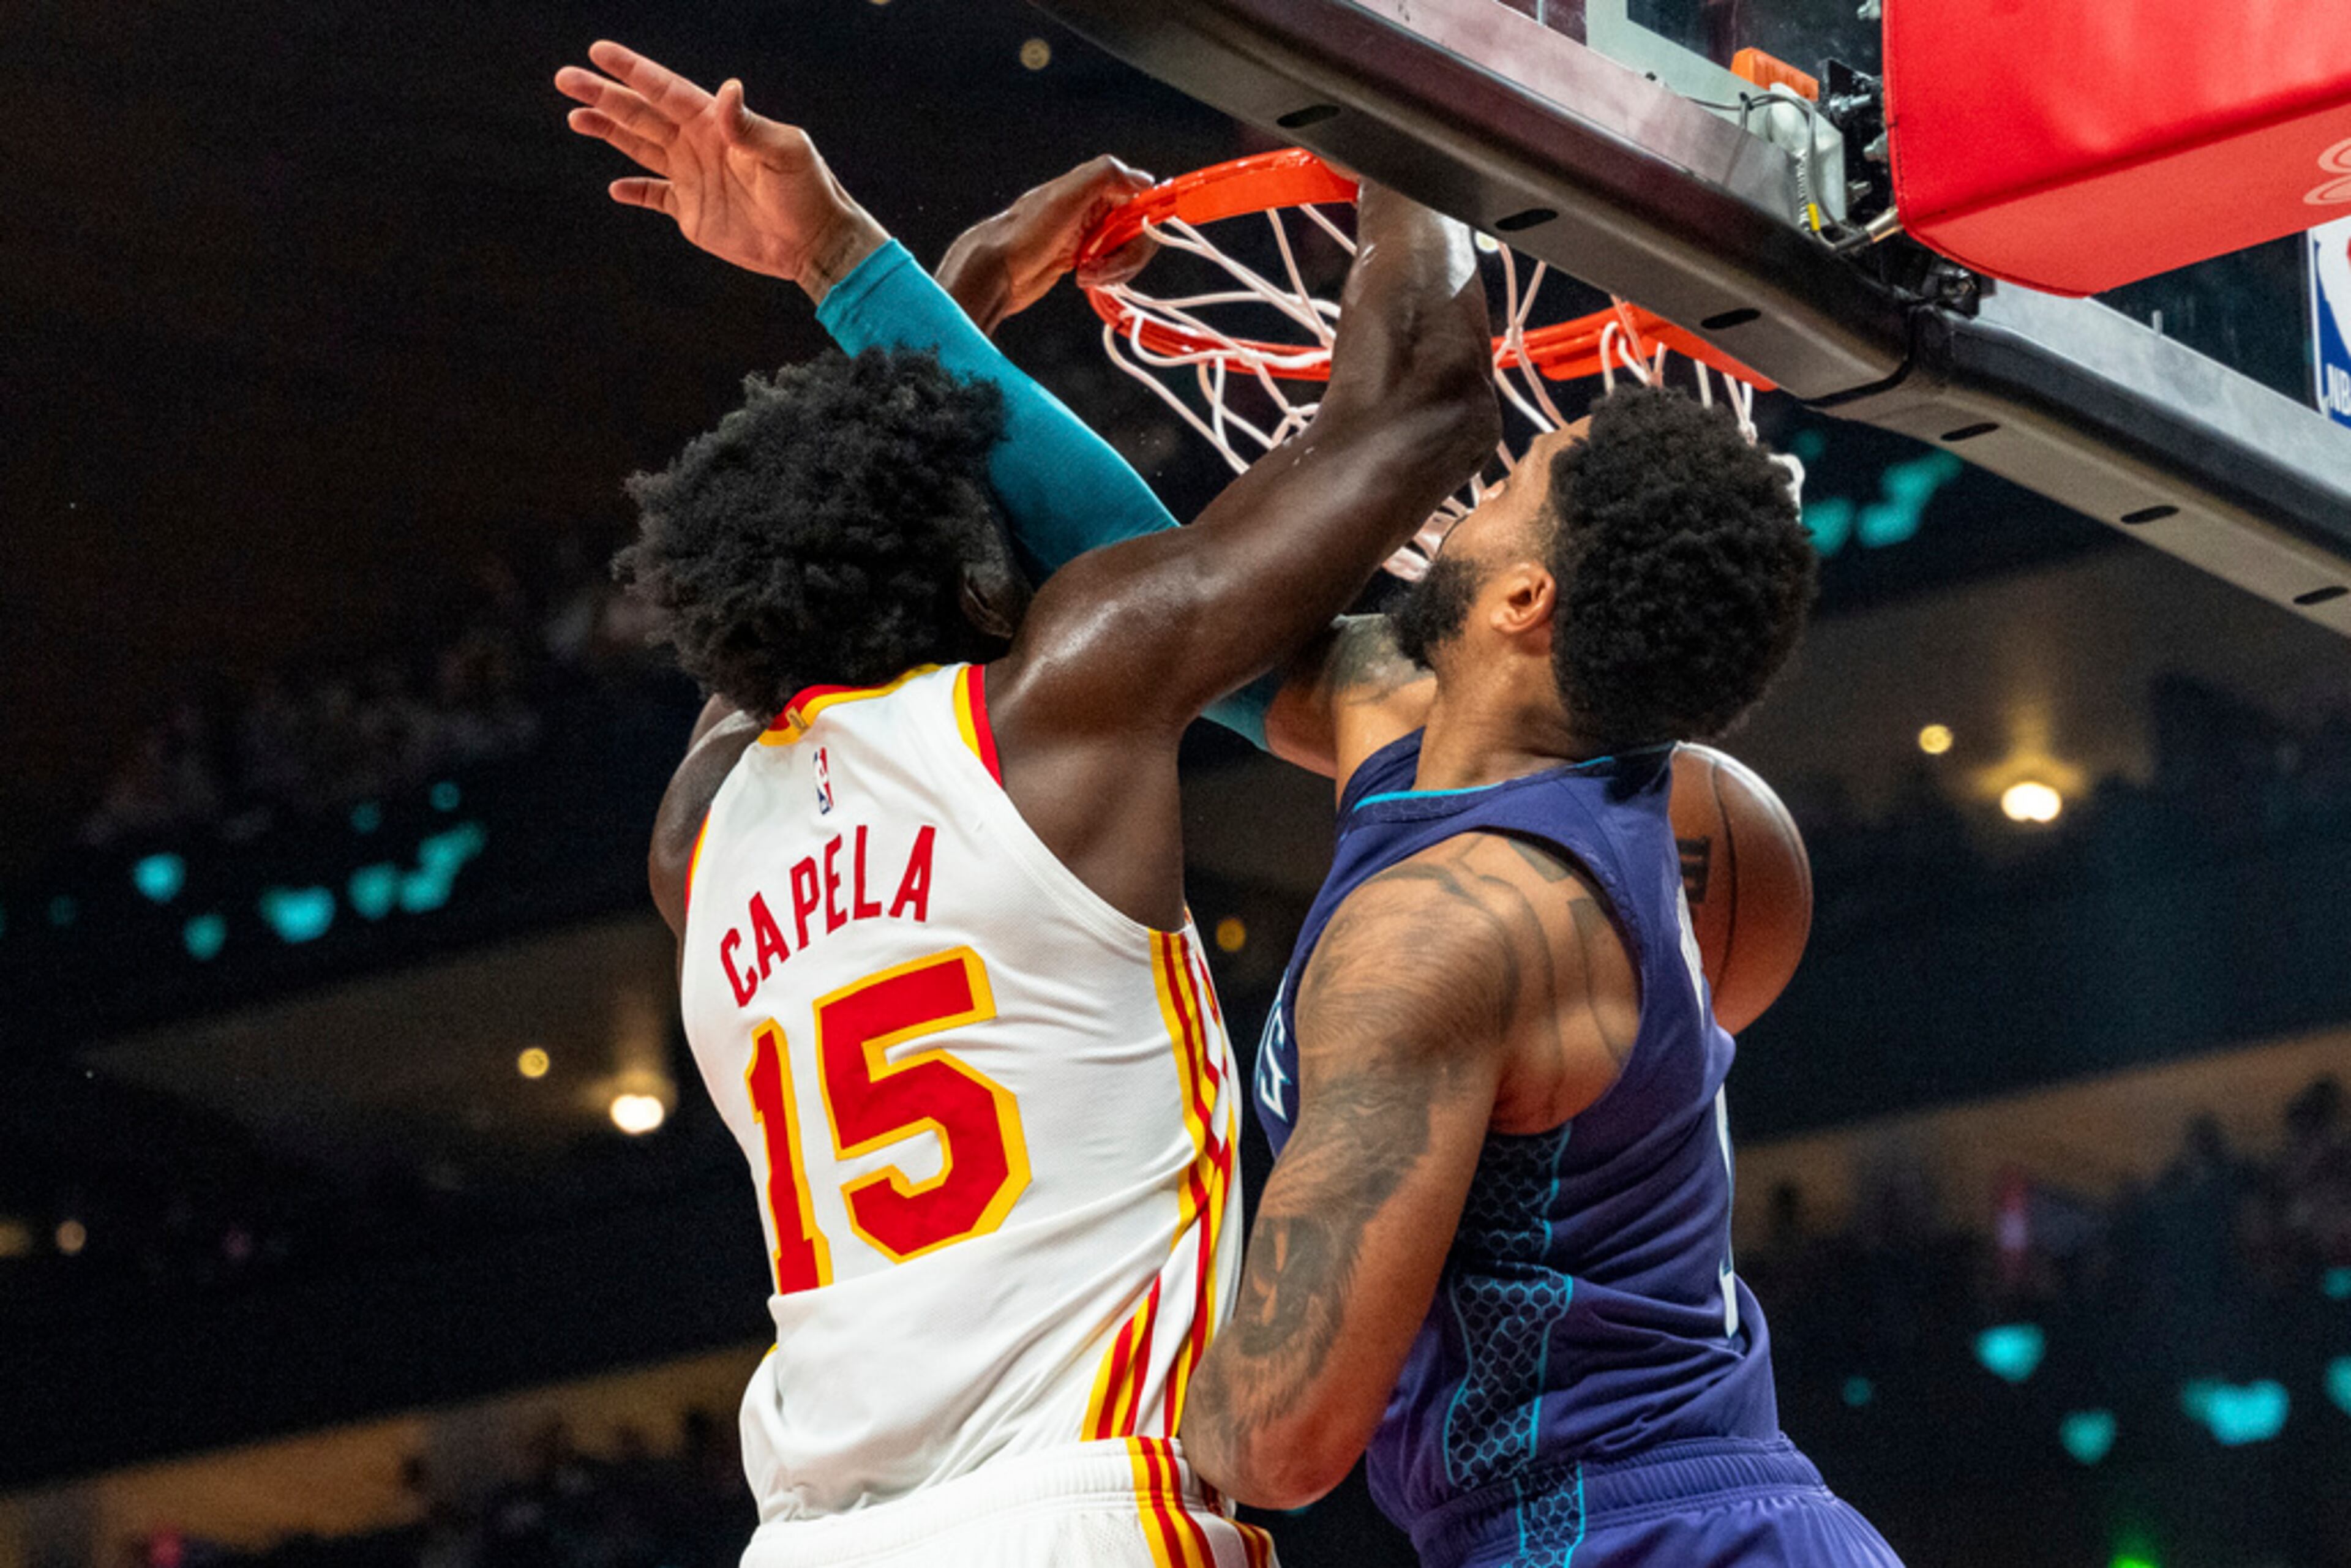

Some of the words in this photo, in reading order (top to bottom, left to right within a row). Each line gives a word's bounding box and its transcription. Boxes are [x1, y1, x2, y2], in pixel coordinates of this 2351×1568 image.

[2327, 362, 2351, 416] NB
[720, 825, 936, 1008] CAPELA
[745, 945, 1032, 1296] 15
